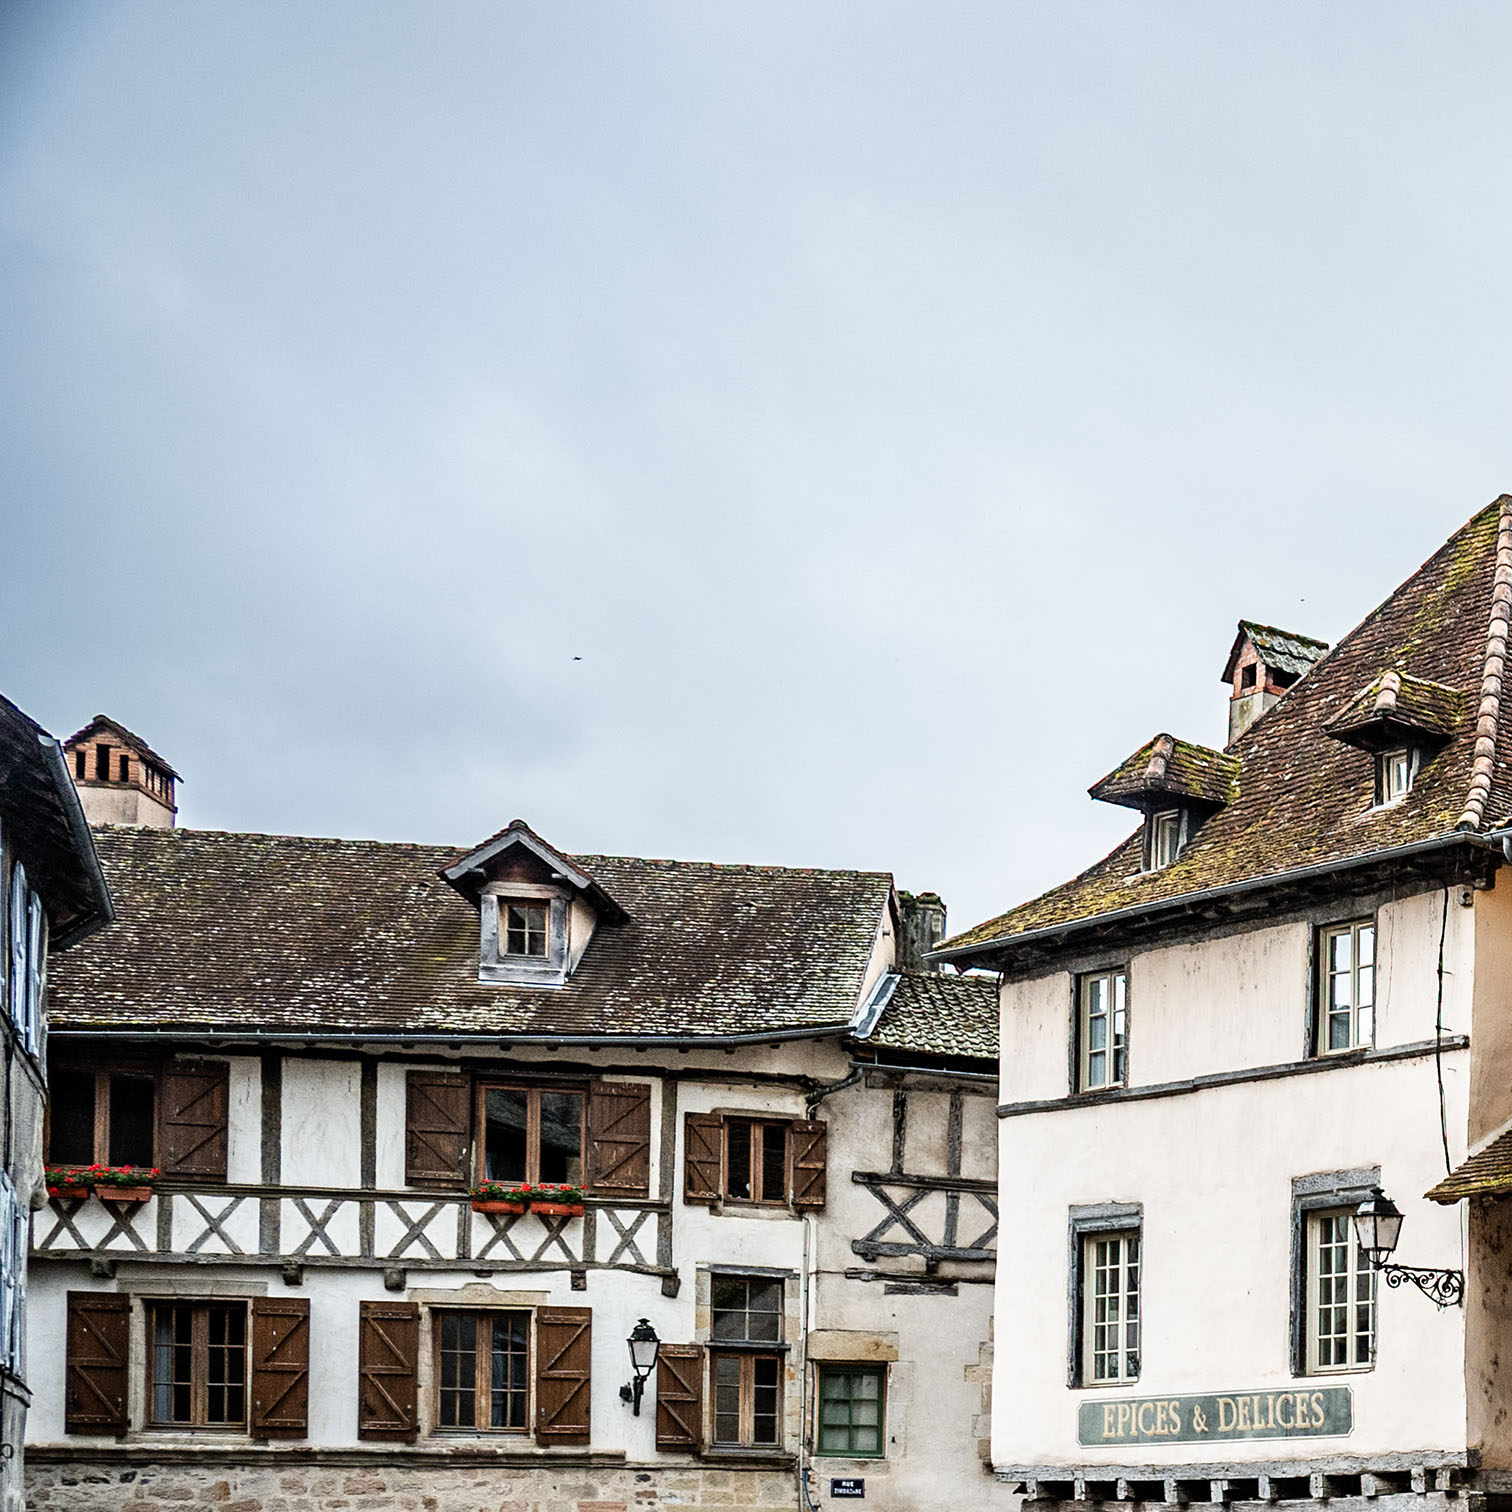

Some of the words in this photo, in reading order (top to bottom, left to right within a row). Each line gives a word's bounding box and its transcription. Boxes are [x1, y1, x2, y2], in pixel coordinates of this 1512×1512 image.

[1102, 1400, 1181, 1438] EPICES
[1192, 1403, 1209, 1433] &
[1216, 1391, 1326, 1432] DELICES
